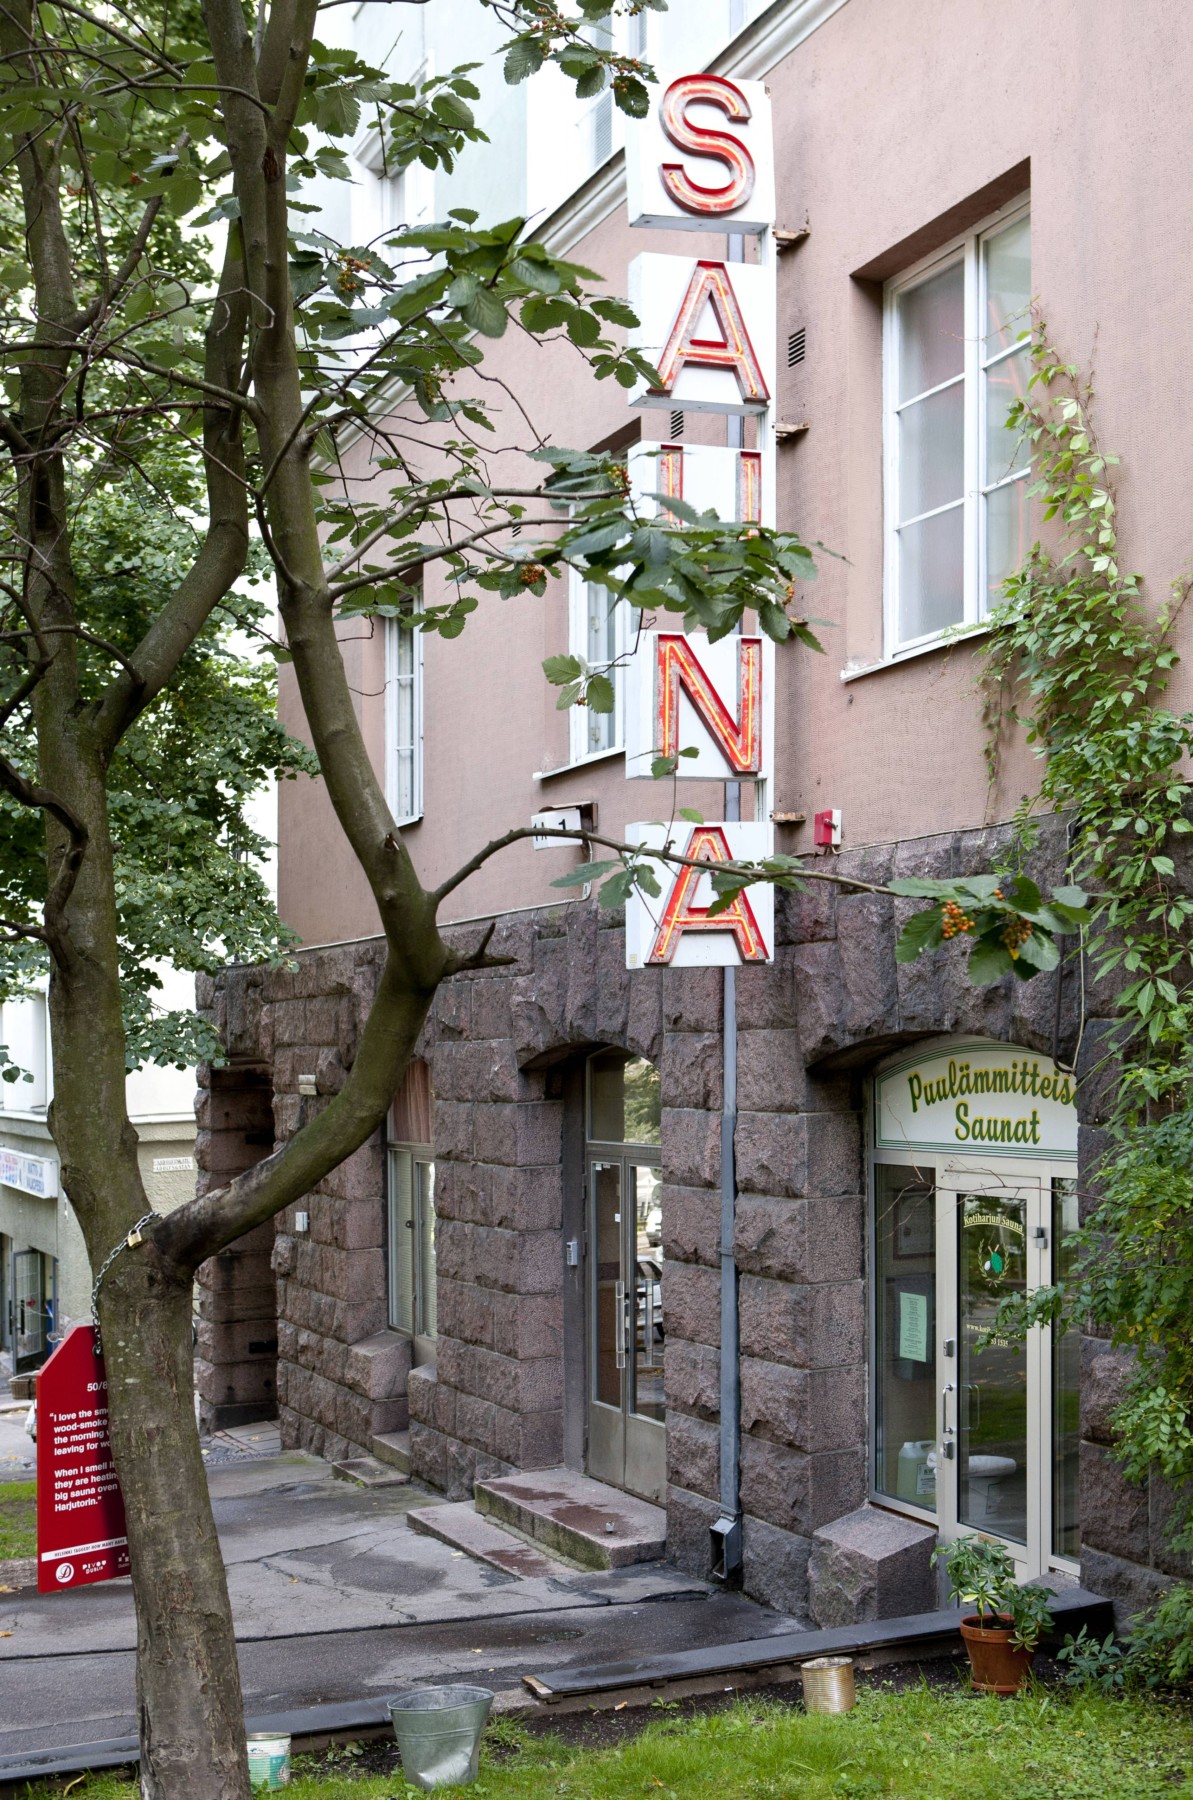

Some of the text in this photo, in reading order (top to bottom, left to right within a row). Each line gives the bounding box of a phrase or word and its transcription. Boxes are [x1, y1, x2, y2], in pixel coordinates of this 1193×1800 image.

[954, 1100, 1041, 1146] Saunat
[963, 1212, 1023, 1233] Kotiharjun Sauna
[58, 1411, 77, 1422] love
[78, 1409, 93, 1418] the
[53, 1419, 108, 1434] wood-smoke
[53, 1435, 69, 1445] the
[70, 1430, 105, 1442] morning
[54, 1444, 85, 1456] leaving
[86, 1442, 99, 1450] for
[54, 1468, 79, 1478] When
[80, 1465, 84, 1474] I
[84, 1461, 108, 1473] smell
[54, 1481, 74, 1490] they
[74, 1478, 90, 1486] are
[54, 1482, 118, 1501] big sauna oven
[54, 1549, 73, 1558] HELSINKI
[101, 1541, 114, 1549] MANY
[85, 1564, 104, 1575] DUBLIN
